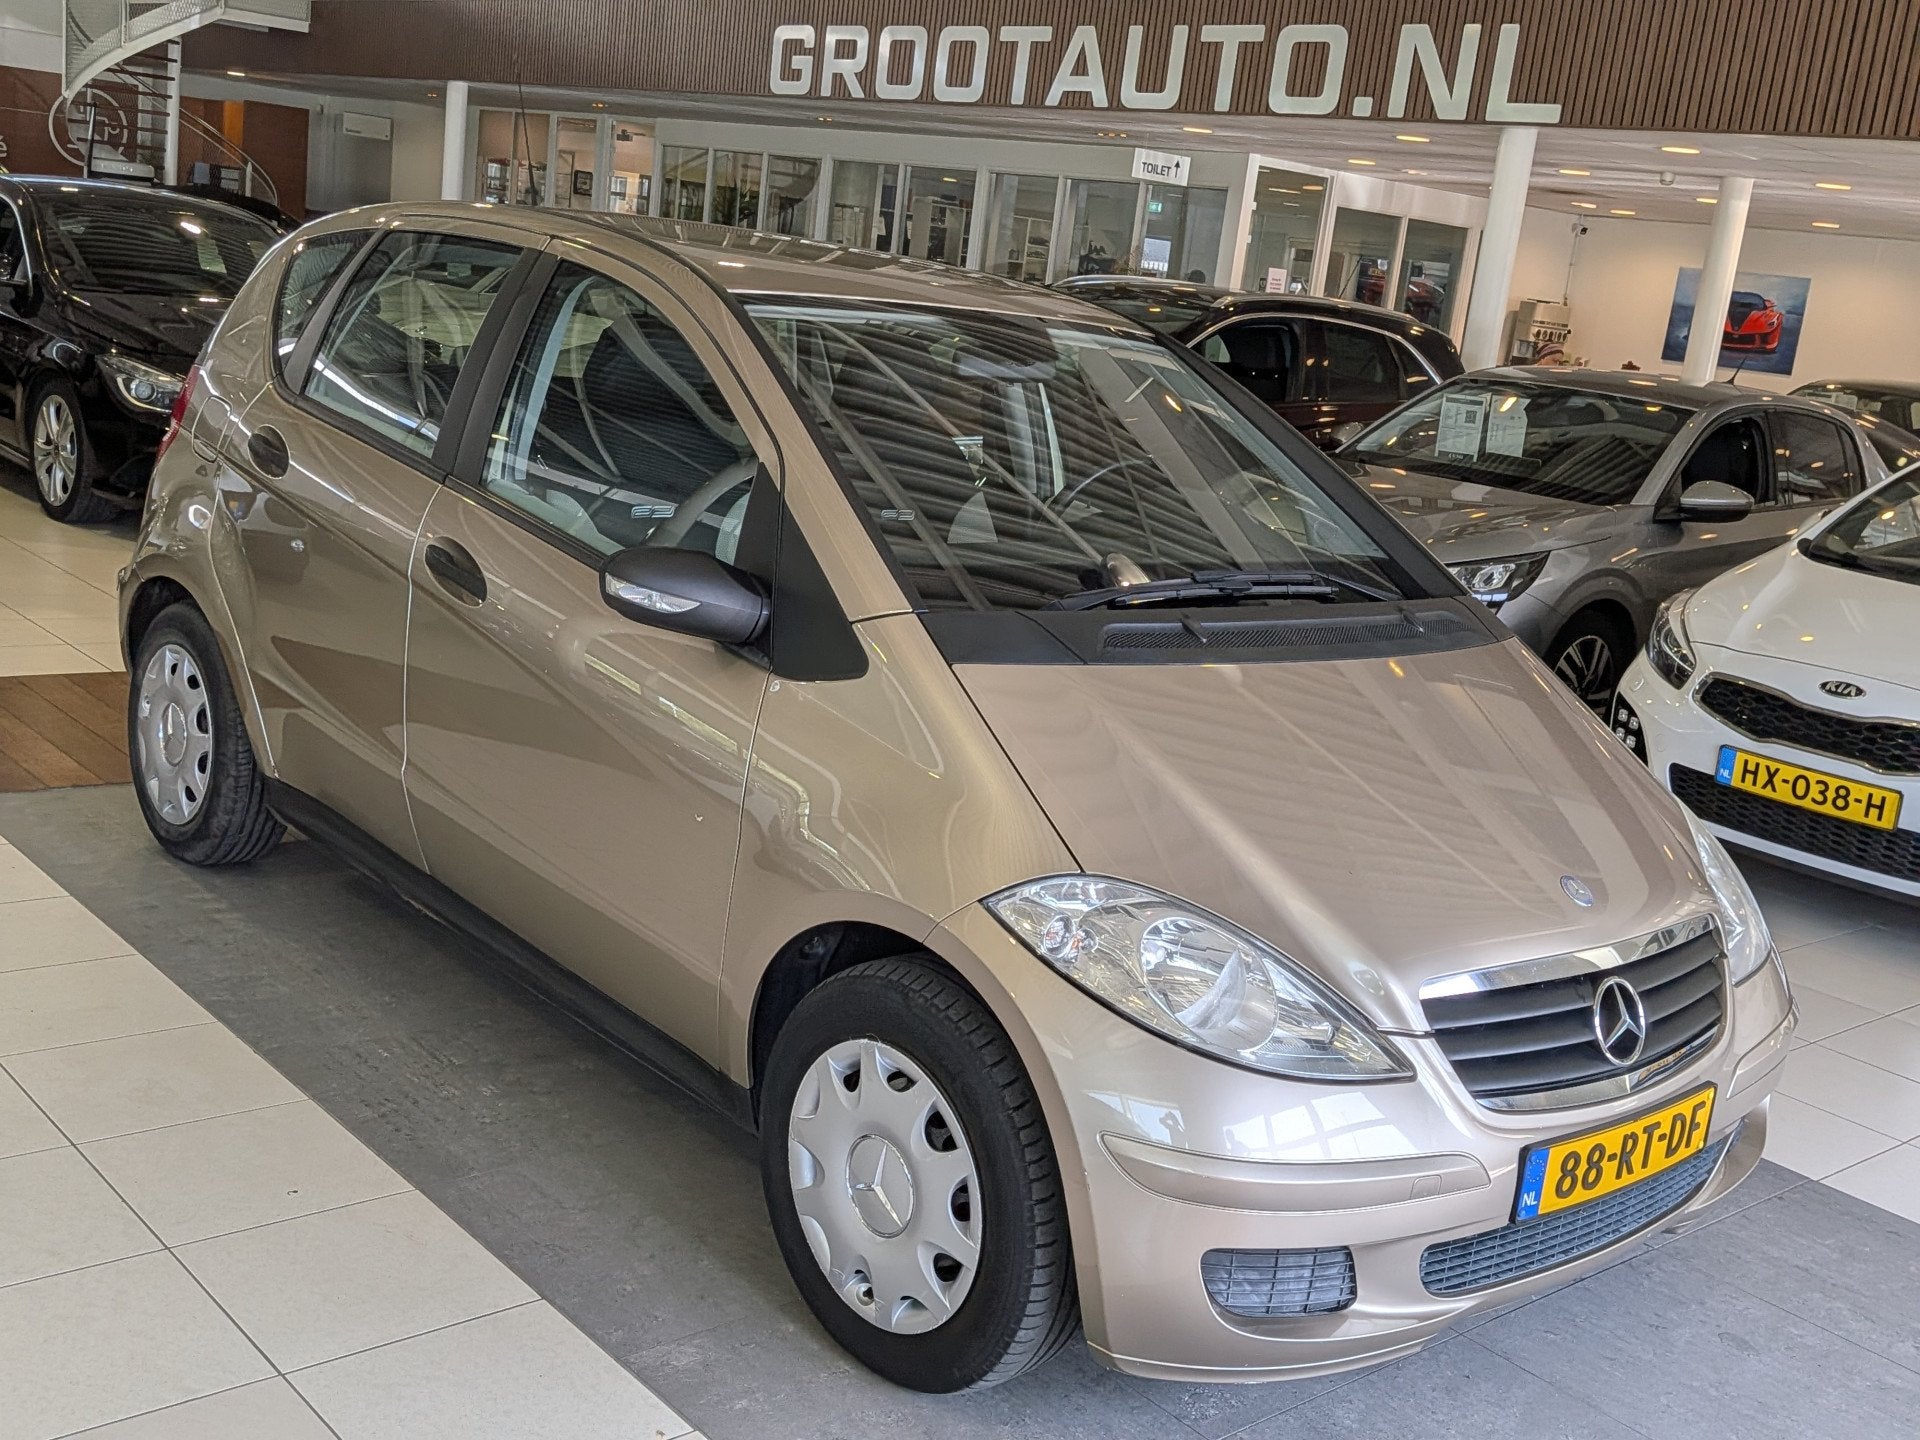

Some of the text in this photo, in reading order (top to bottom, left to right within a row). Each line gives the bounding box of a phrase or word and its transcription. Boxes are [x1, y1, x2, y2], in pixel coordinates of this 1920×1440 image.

[770, 23, 1562, 125] GROOTAUTO.NL
[1142, 161, 1171, 177] TOILET
[1824, 681, 1857, 697] KIA
[1720, 768, 1731, 779] NL
[1741, 759, 1887, 821] HX-038-H
[1555, 1101, 1706, 1199] 88-RT-DF
[1522, 1192, 1537, 1207] NL
